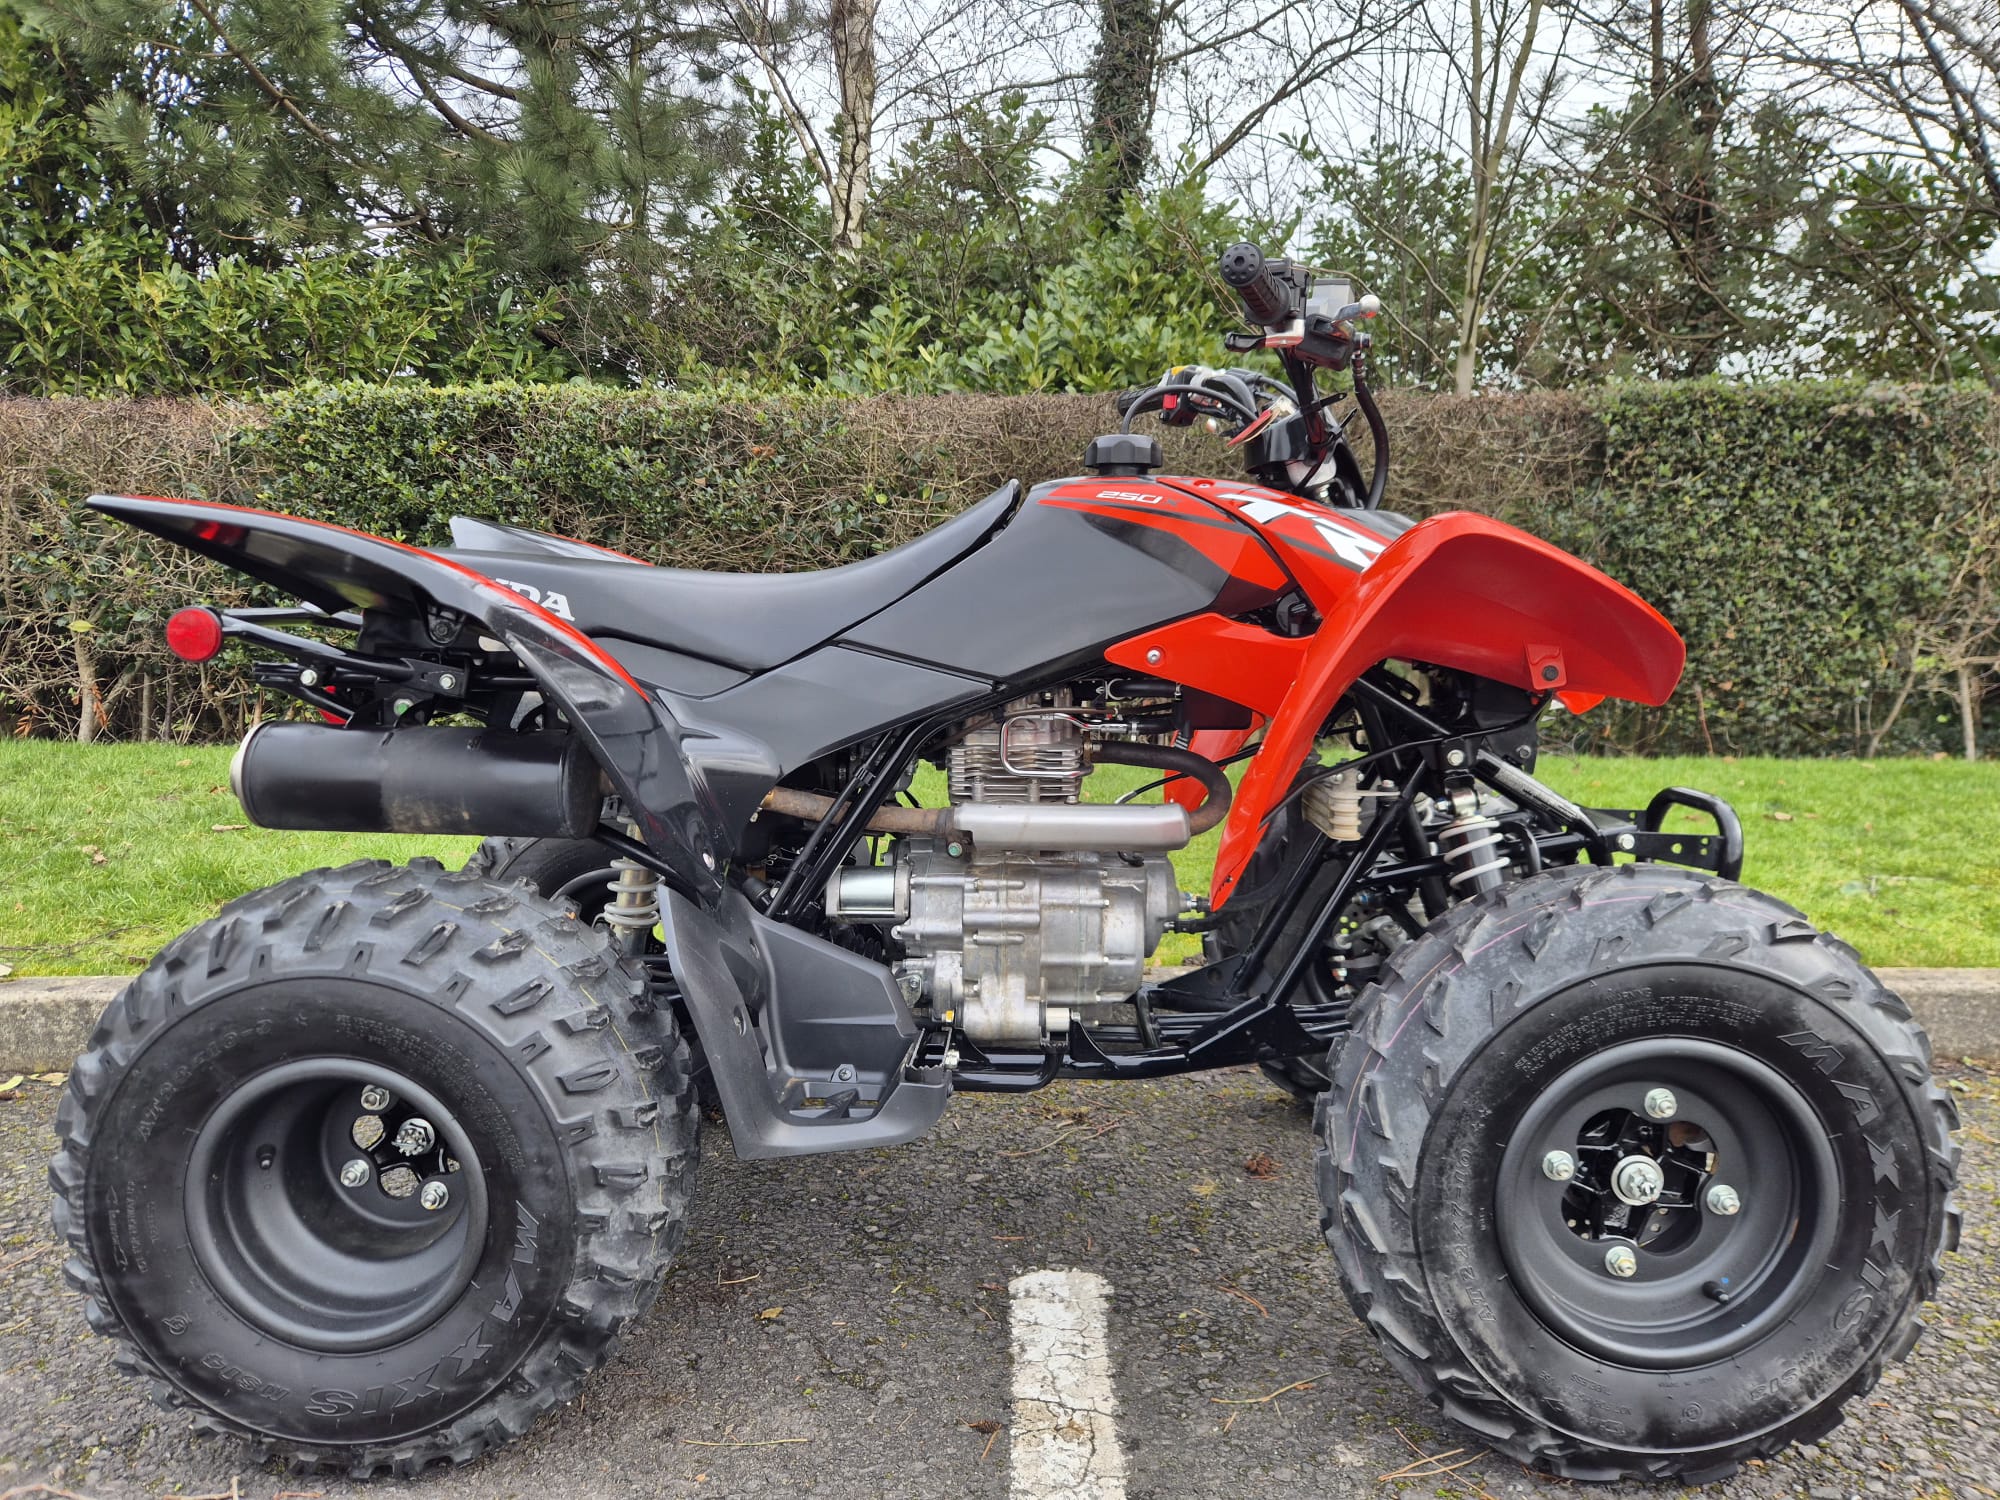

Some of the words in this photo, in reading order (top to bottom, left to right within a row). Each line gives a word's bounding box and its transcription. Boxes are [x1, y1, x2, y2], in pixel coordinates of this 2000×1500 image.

[1776, 1030, 1901, 1338] MAXXIS
[201, 1352, 290, 1401] MS14
[305, 1200, 540, 1417] MAXXIS
